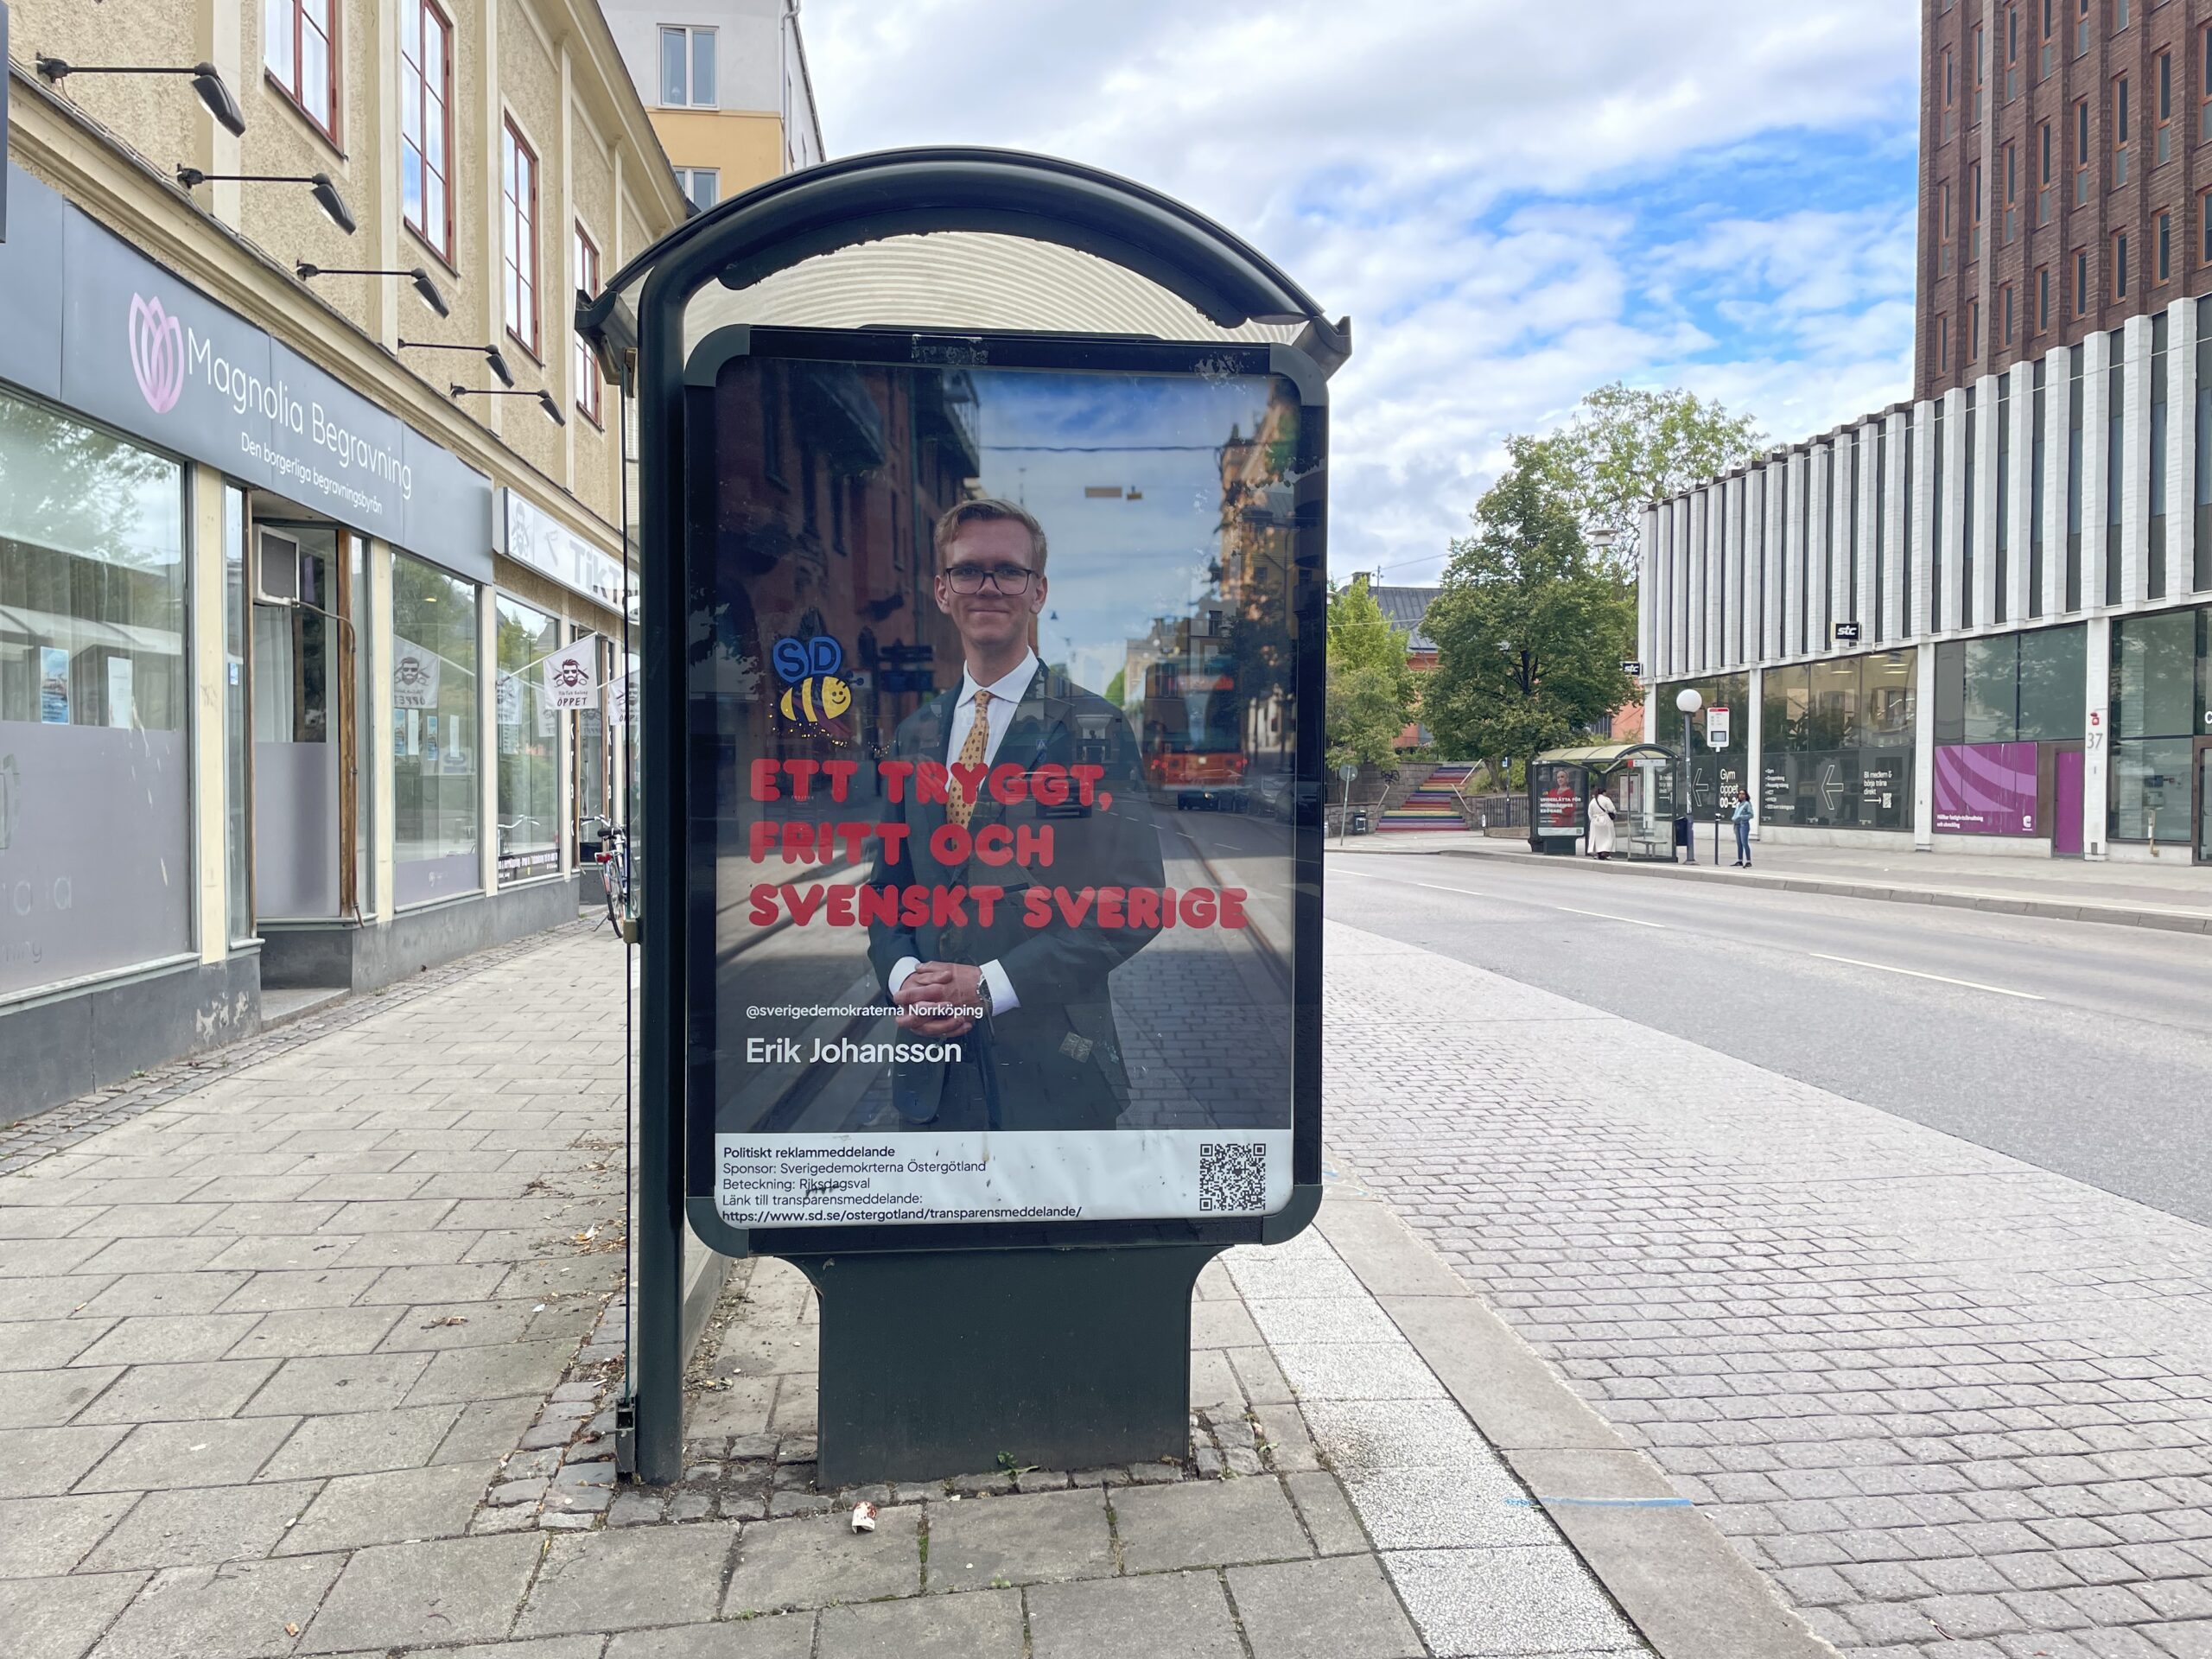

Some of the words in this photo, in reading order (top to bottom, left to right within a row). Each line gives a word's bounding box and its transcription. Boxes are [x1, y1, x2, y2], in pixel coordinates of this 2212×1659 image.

[188, 326, 303, 435] Magnolia
[311, 402, 411, 499] Begravning
[241, 432, 262, 459] Den
[264, 442, 311, 484] borgerliga
[313, 467, 383, 516] begravningsbyrån
[1837, 625, 1857, 636] stc
[775, 639, 839, 678] SD
[2087, 733, 2103, 750] 37
[1719, 768, 1736, 782] Gym
[750, 759, 858, 802] ETT
[878, 761, 1113, 811] TRYGGT,
[1719, 783, 1738, 797] öppet
[748, 821, 911, 865] FRITT
[930, 823, 1054, 867] OCH
[748, 883, 1004, 928] SVENSKT
[1023, 886, 1248, 929] SVERIGE
[746, 1004, 905, 1020] @sverigedemokraterna
[909, 1004, 984, 1020] Norrköping
[747, 1037, 802, 1064] Erik
[809, 1037, 962, 1064] Johansson
[723, 1147, 772, 1159] Politiskt
[775, 1146, 895, 1159] reklammeddelande
[722, 1162, 777, 1177] Sponsor:
[780, 1161, 904, 1177] Sverigedemokrterna
[906, 1159, 987, 1175] Östergötland
[722, 1179, 796, 1192] Beteckning:
[799, 1177, 871, 1193] Riksdagsval
[722, 1194, 752, 1206] Länk
[755, 1193, 768, 1206] till
[772, 1192, 923, 1208] transparensmeddelande:
[722, 1206, 1083, 1224] https://www.sd.se/ostergotland/transparensmeddelande/
